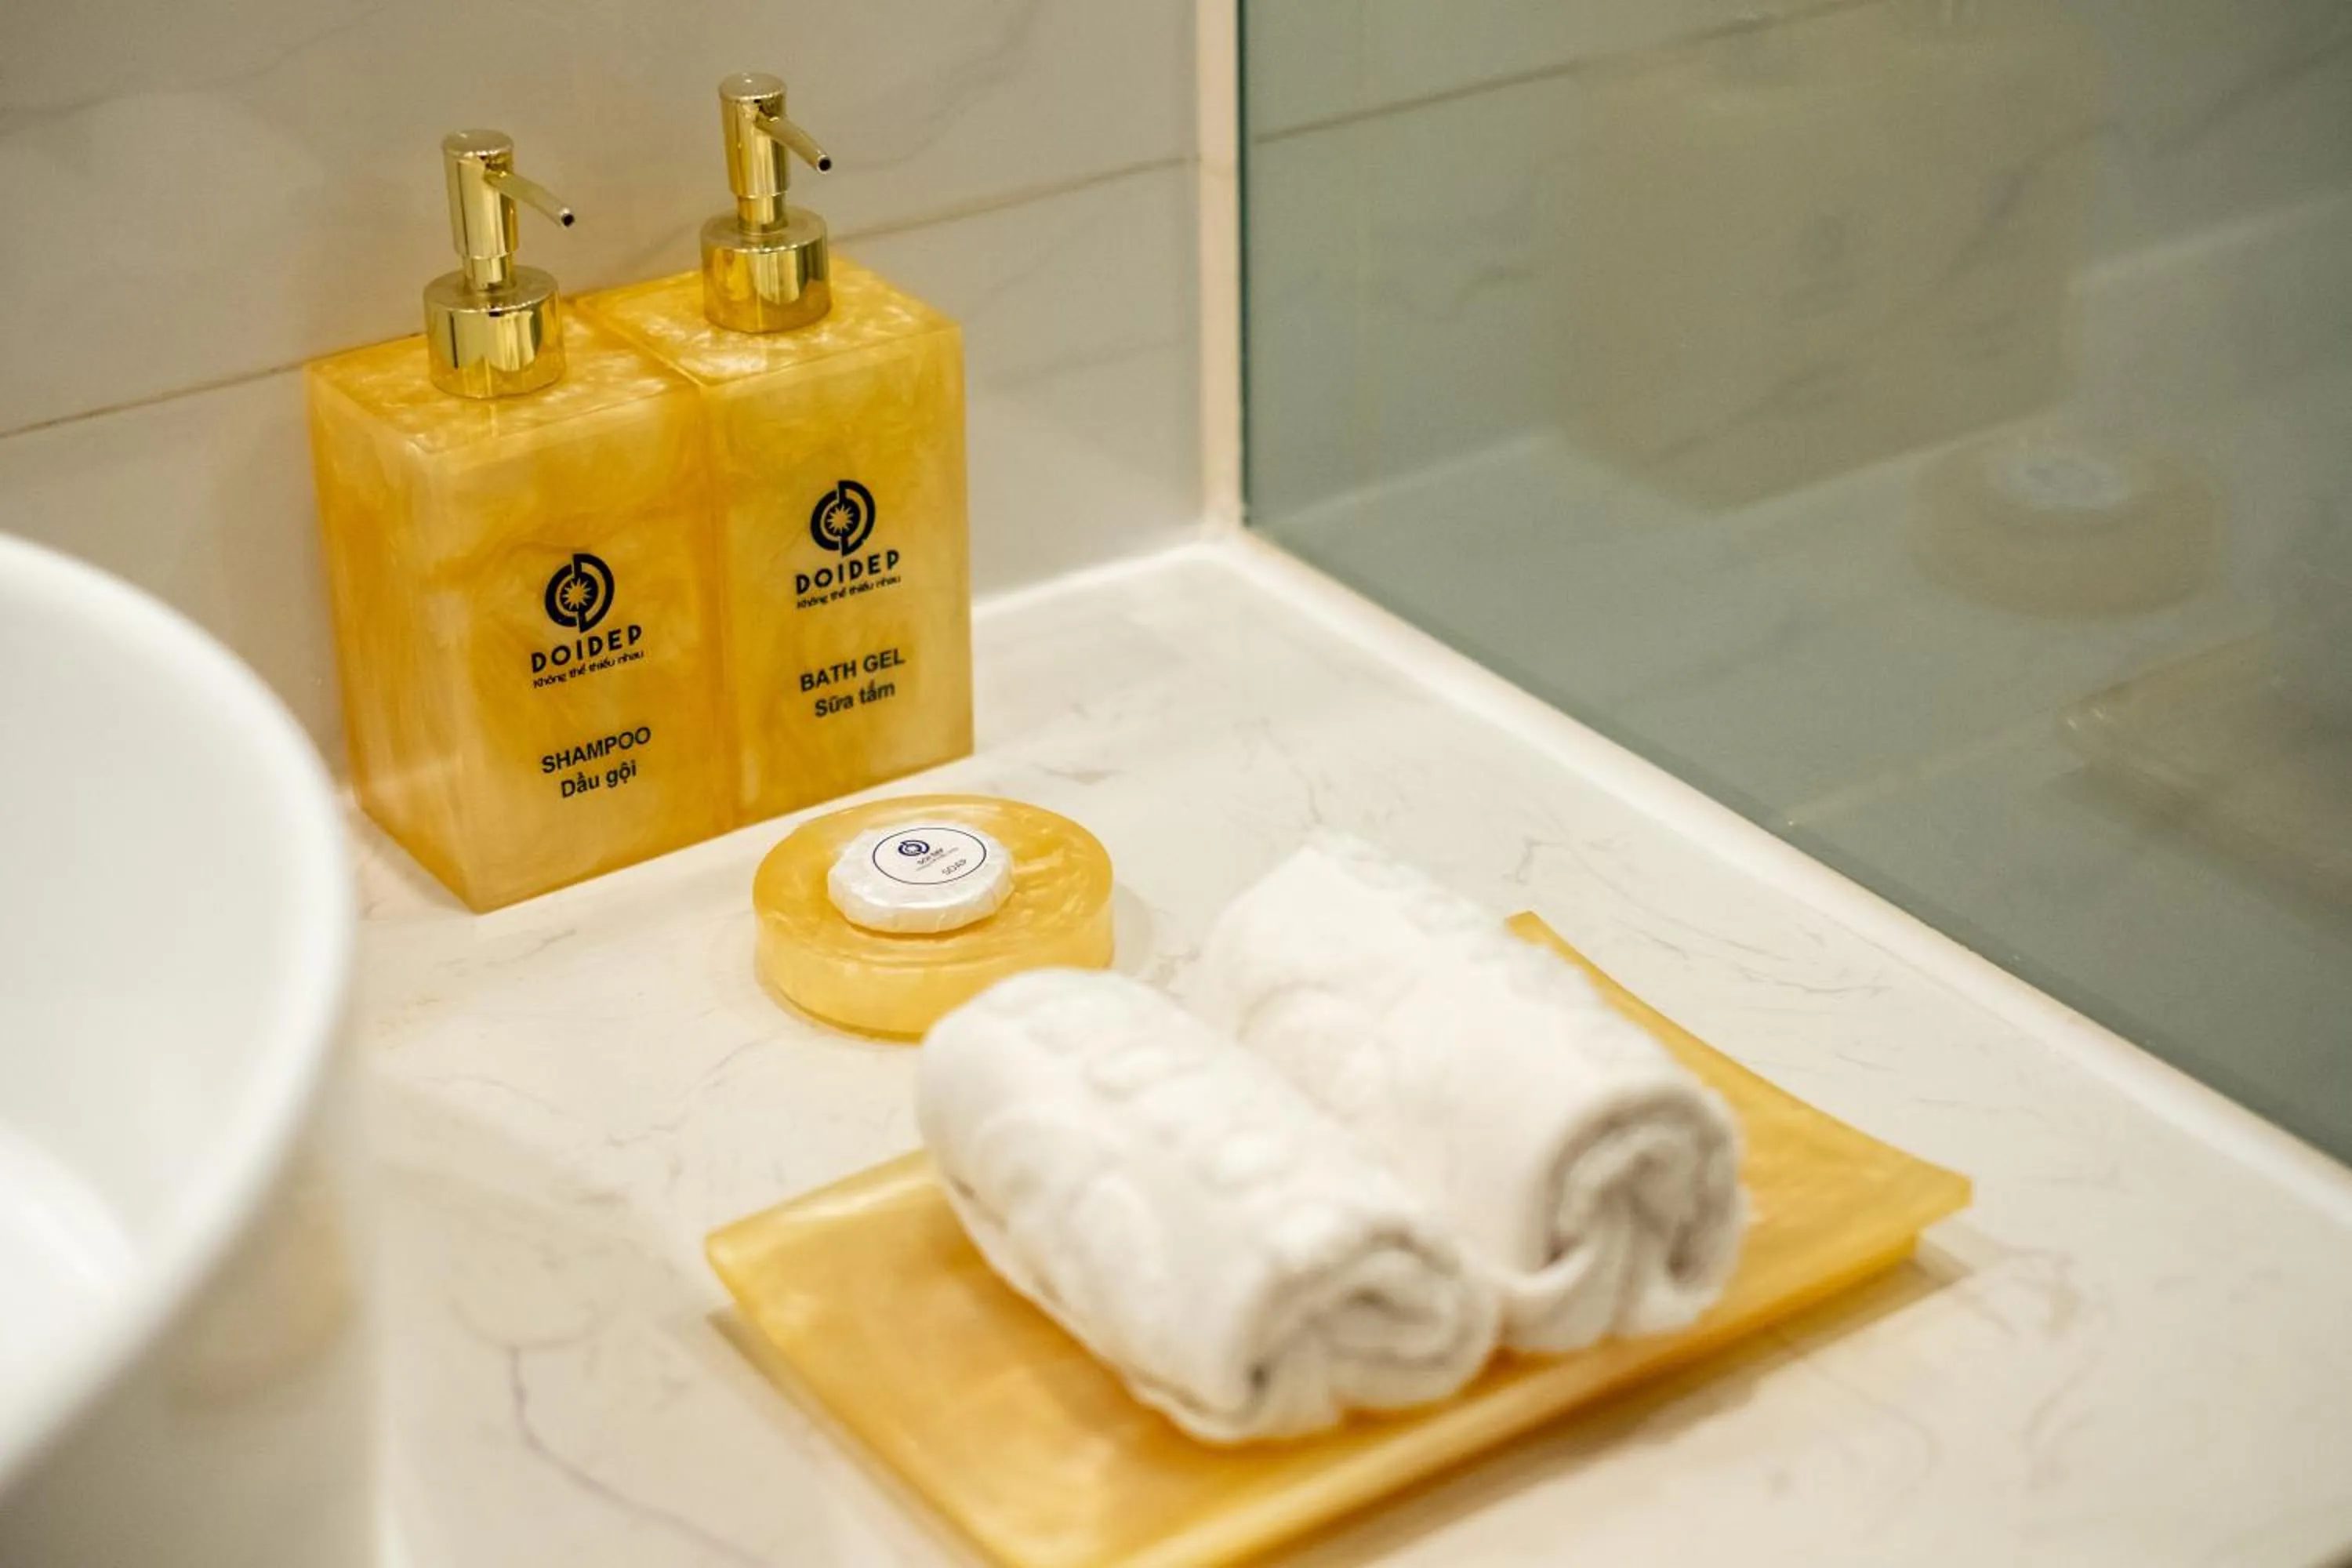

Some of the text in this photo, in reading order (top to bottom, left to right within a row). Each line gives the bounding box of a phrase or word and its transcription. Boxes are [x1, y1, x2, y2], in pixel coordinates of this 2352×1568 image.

[796, 550, 899, 595] DOIDEP
[531, 624, 641, 673] DOIDEP
[800, 648, 906, 692] BATH GEL
[815, 679, 895, 717] Sữa tắm
[541, 727, 651, 773] SHAMPOO
[561, 759, 637, 798] Dầu gội
